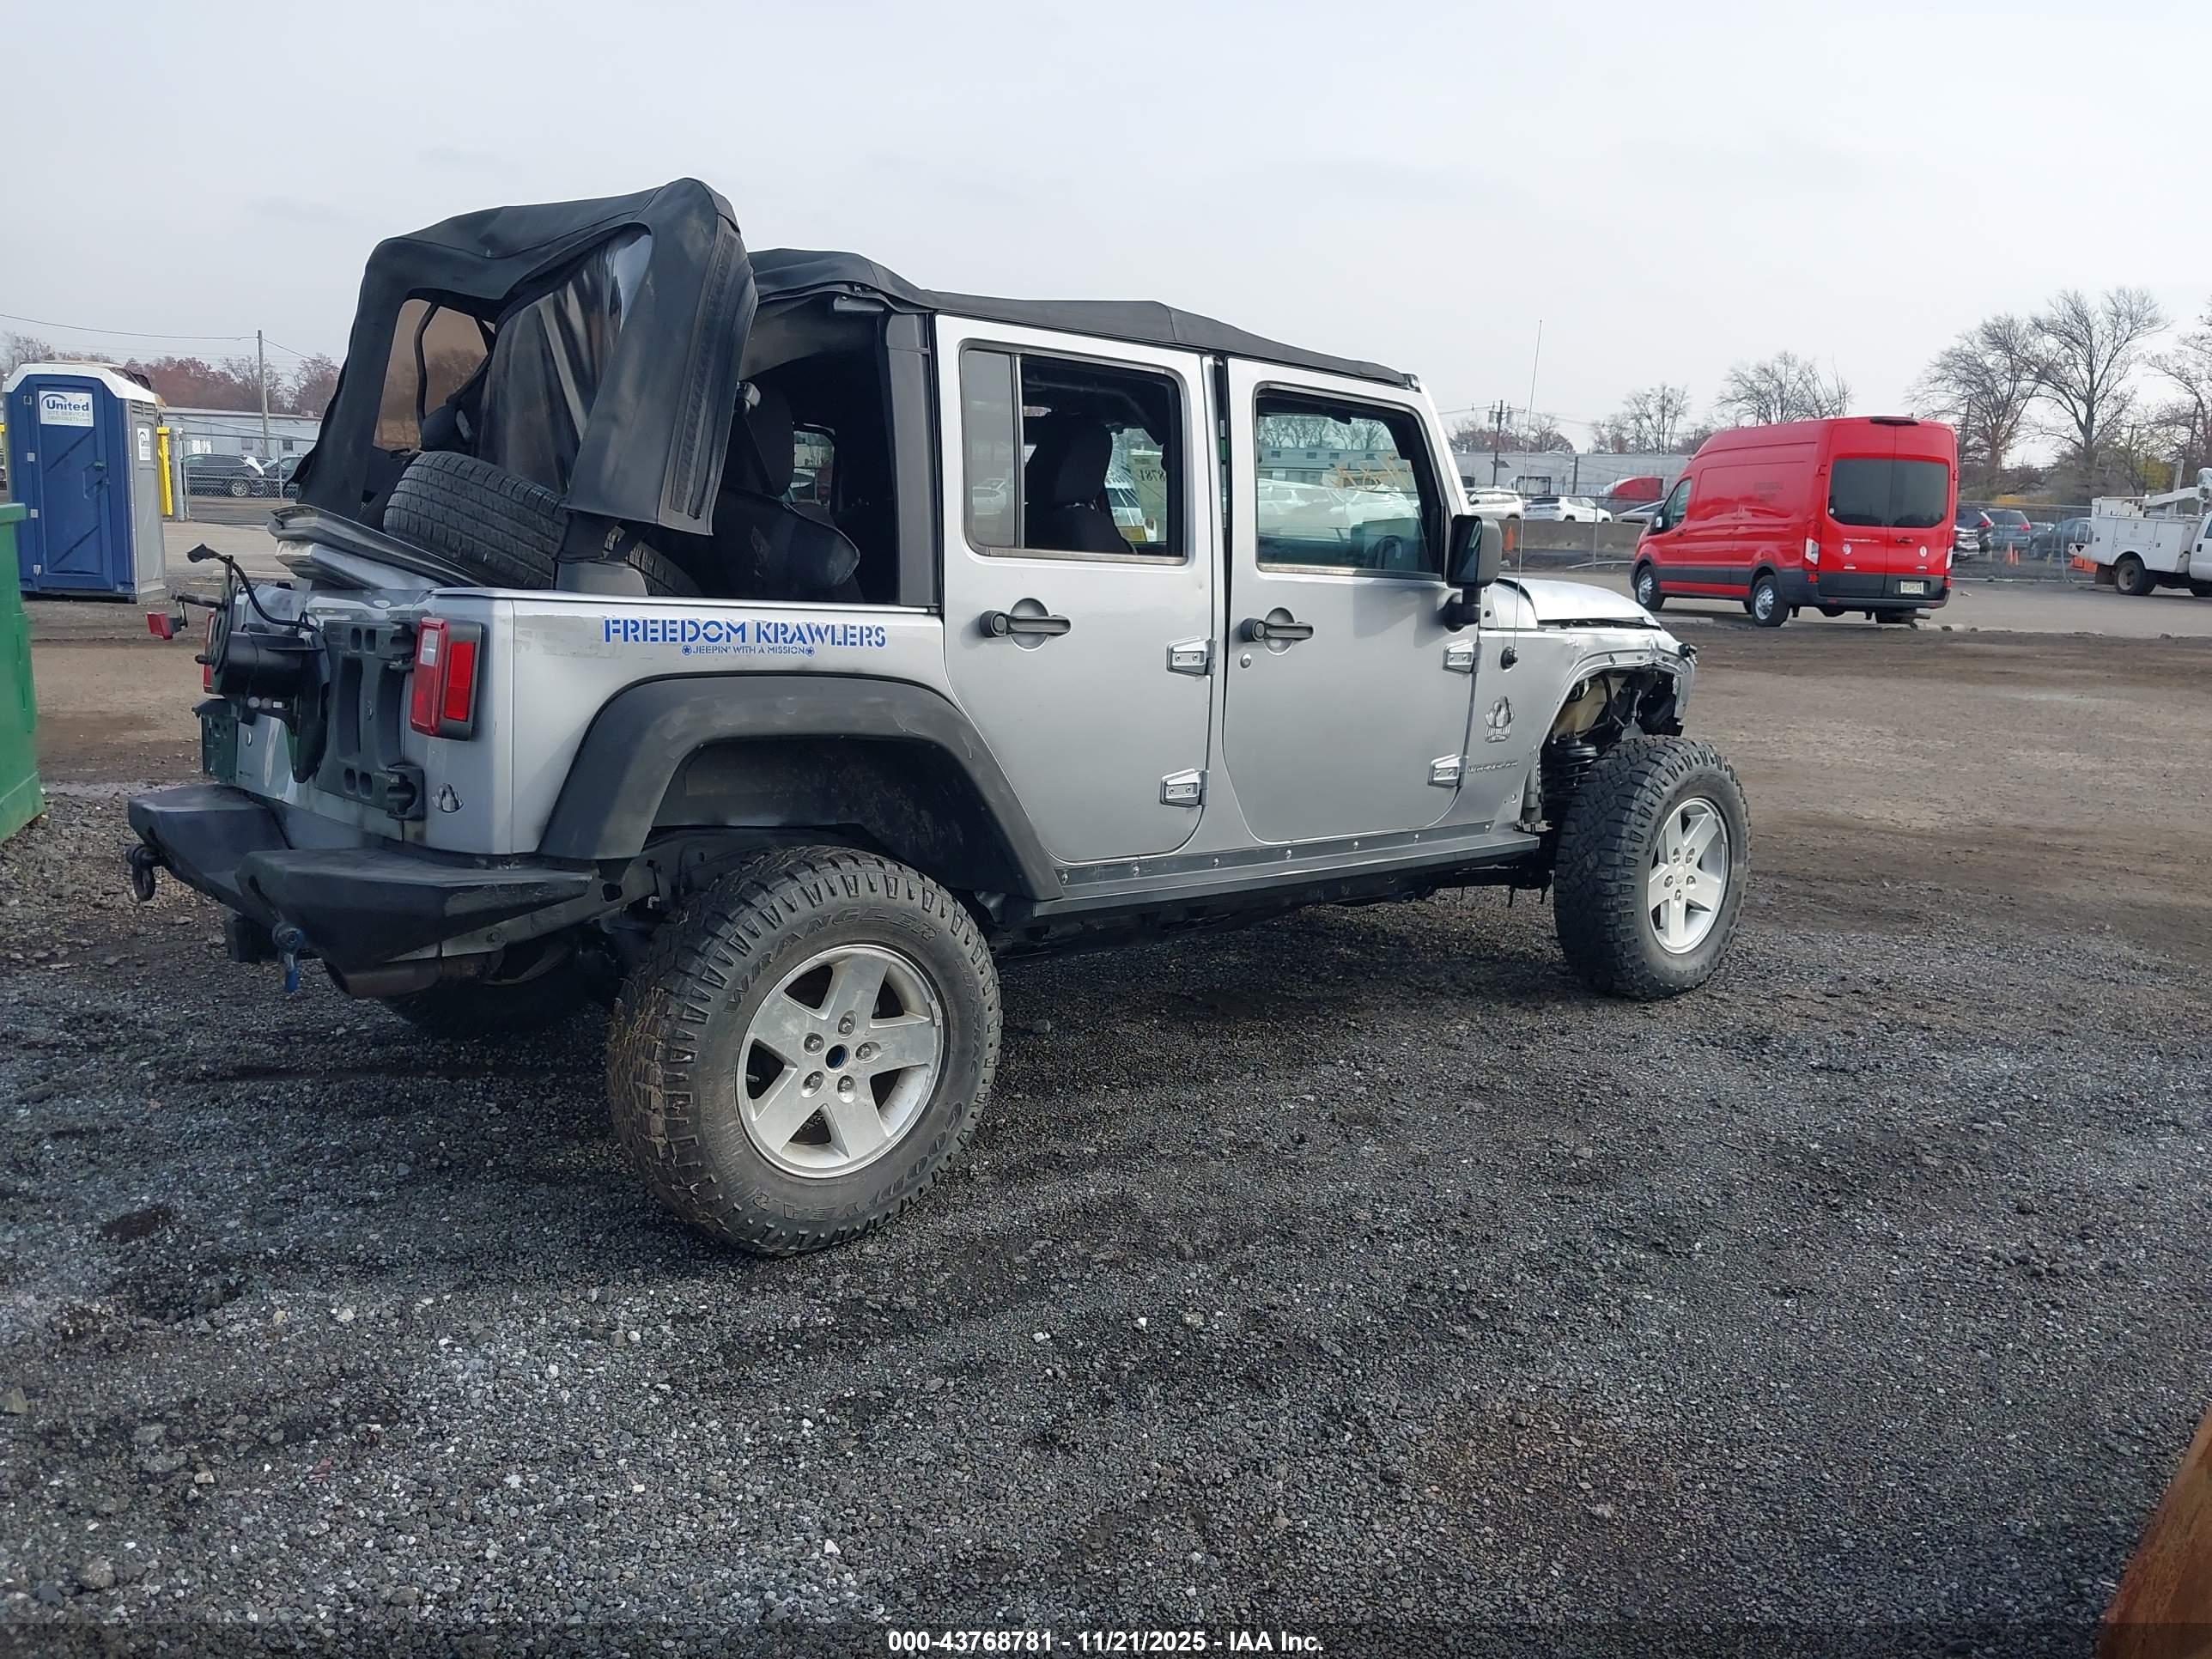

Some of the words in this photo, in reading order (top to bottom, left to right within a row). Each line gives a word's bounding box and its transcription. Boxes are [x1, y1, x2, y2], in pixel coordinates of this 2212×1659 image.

[46, 399, 89, 411] United
[604, 618, 747, 643] FREEDOM
[756, 621, 887, 647] KRAWLERS
[732, 646, 756, 654] WITH
[758, 646, 765, 654] A
[767, 646, 805, 655] MISSION
[724, 906, 940, 1014] WRANGLER
